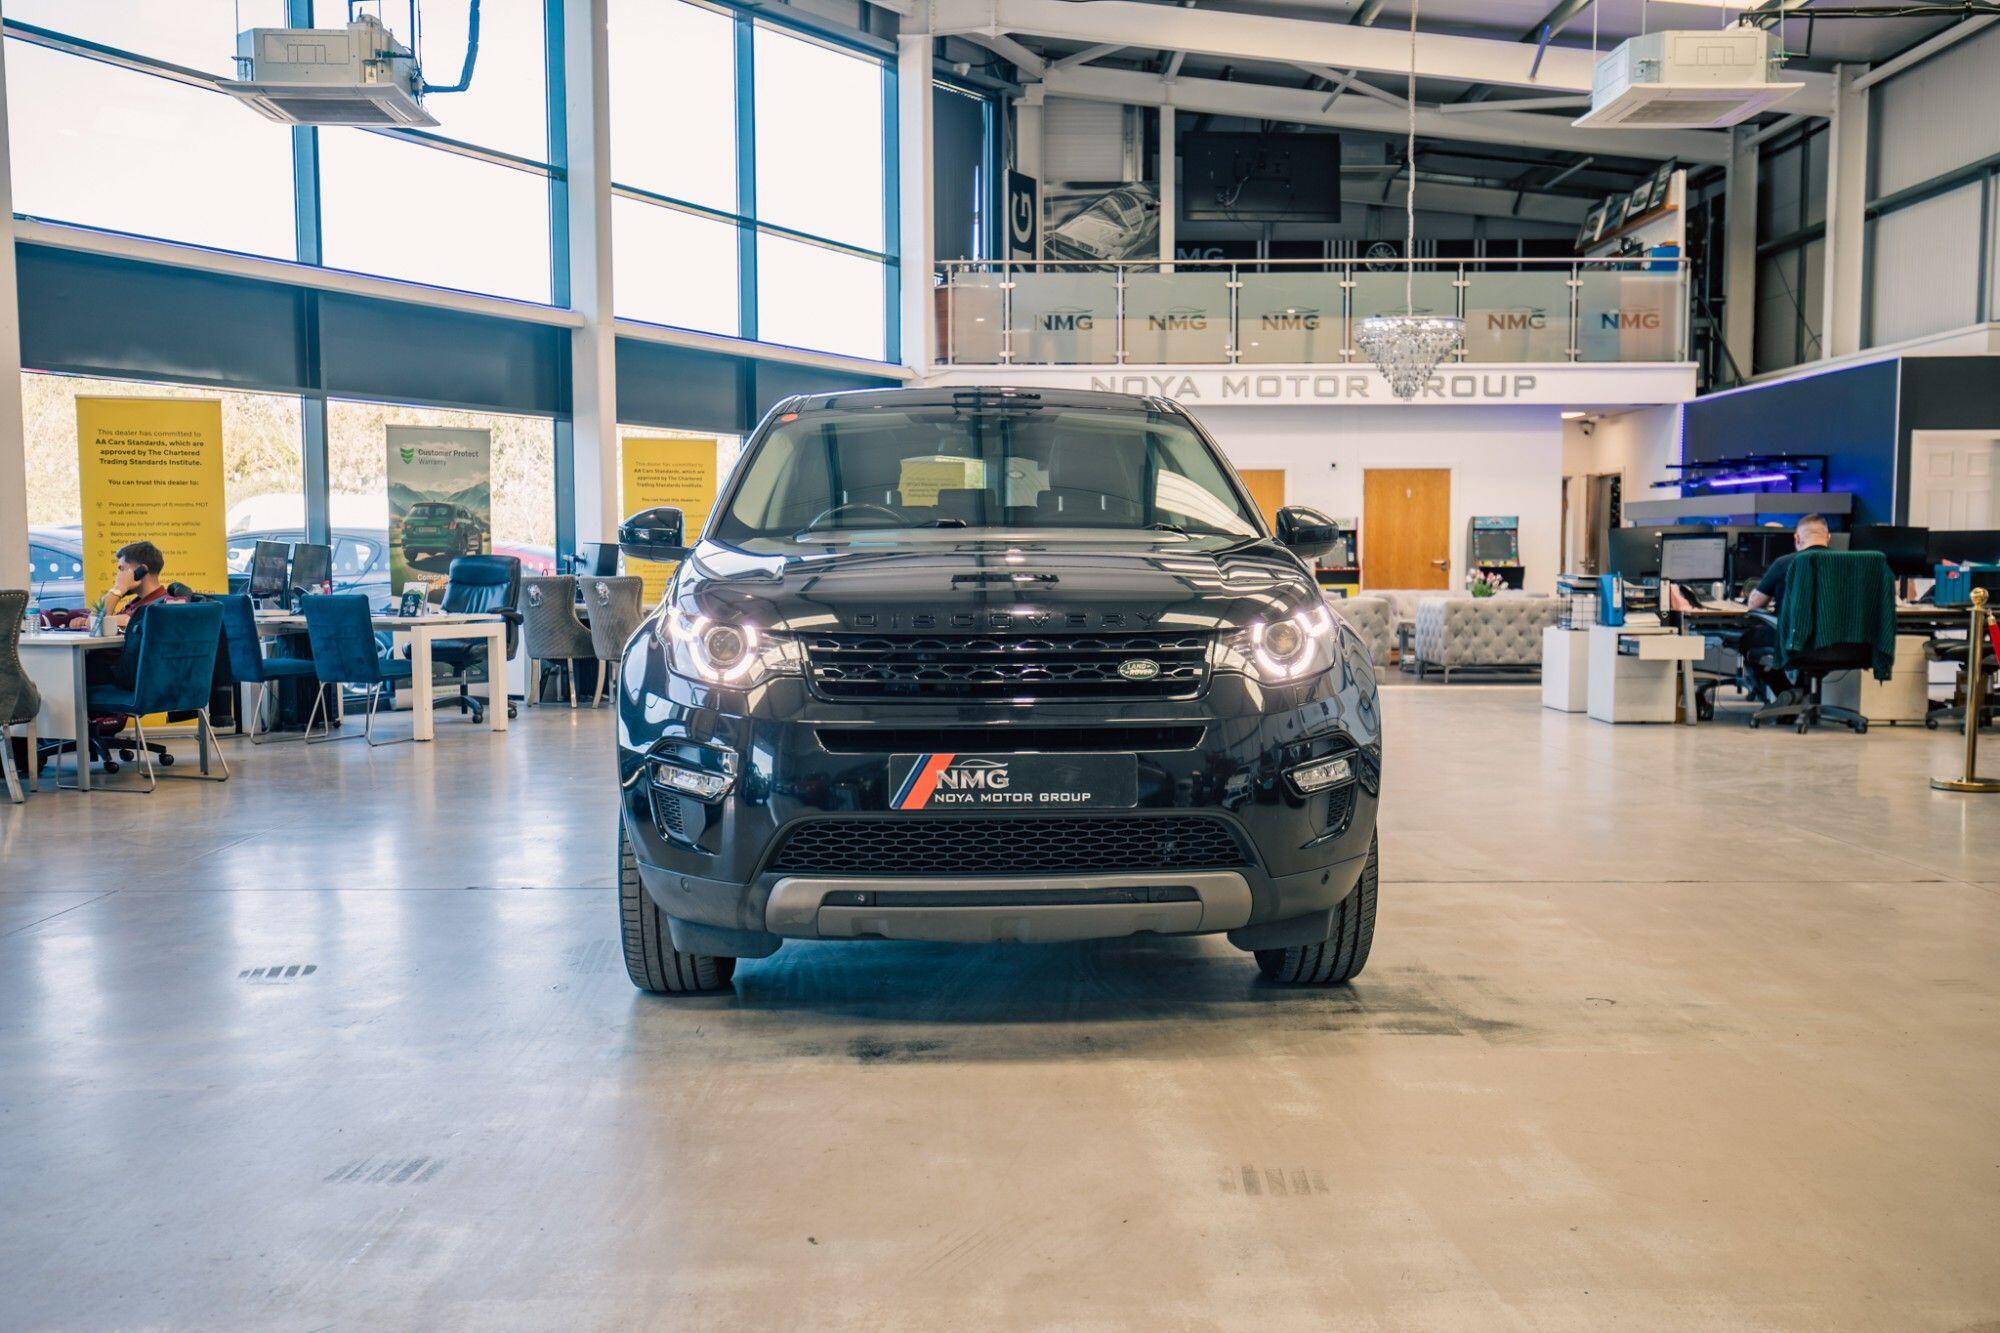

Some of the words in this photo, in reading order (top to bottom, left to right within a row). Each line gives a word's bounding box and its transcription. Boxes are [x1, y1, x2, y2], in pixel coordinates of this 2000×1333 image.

[1035, 315, 1093, 331] NMG
[1149, 314, 1207, 331] NMG
[1262, 314, 1320, 331] NMG
[1488, 314, 1546, 330] NMG
[1602, 313, 1660, 329] NMG
[1091, 375, 1200, 398] NOYA
[1222, 375, 1370, 398] MOTOR
[1392, 375, 1537, 398] ROUP
[127, 439, 168, 447] Standards,
[137, 449, 146, 457] by
[418, 449, 452, 457] Customer
[453, 450, 479, 458] Protect
[99, 458, 128, 466] Trading
[129, 458, 168, 466] Standards
[854, 612, 1160, 628] DISCOVERY
[936, 769, 1009, 789] NMG
[934, 793, 974, 803] NOYA
[981, 793, 1033, 802] MOTOR
[1039, 793, 1091, 802] GROUP
